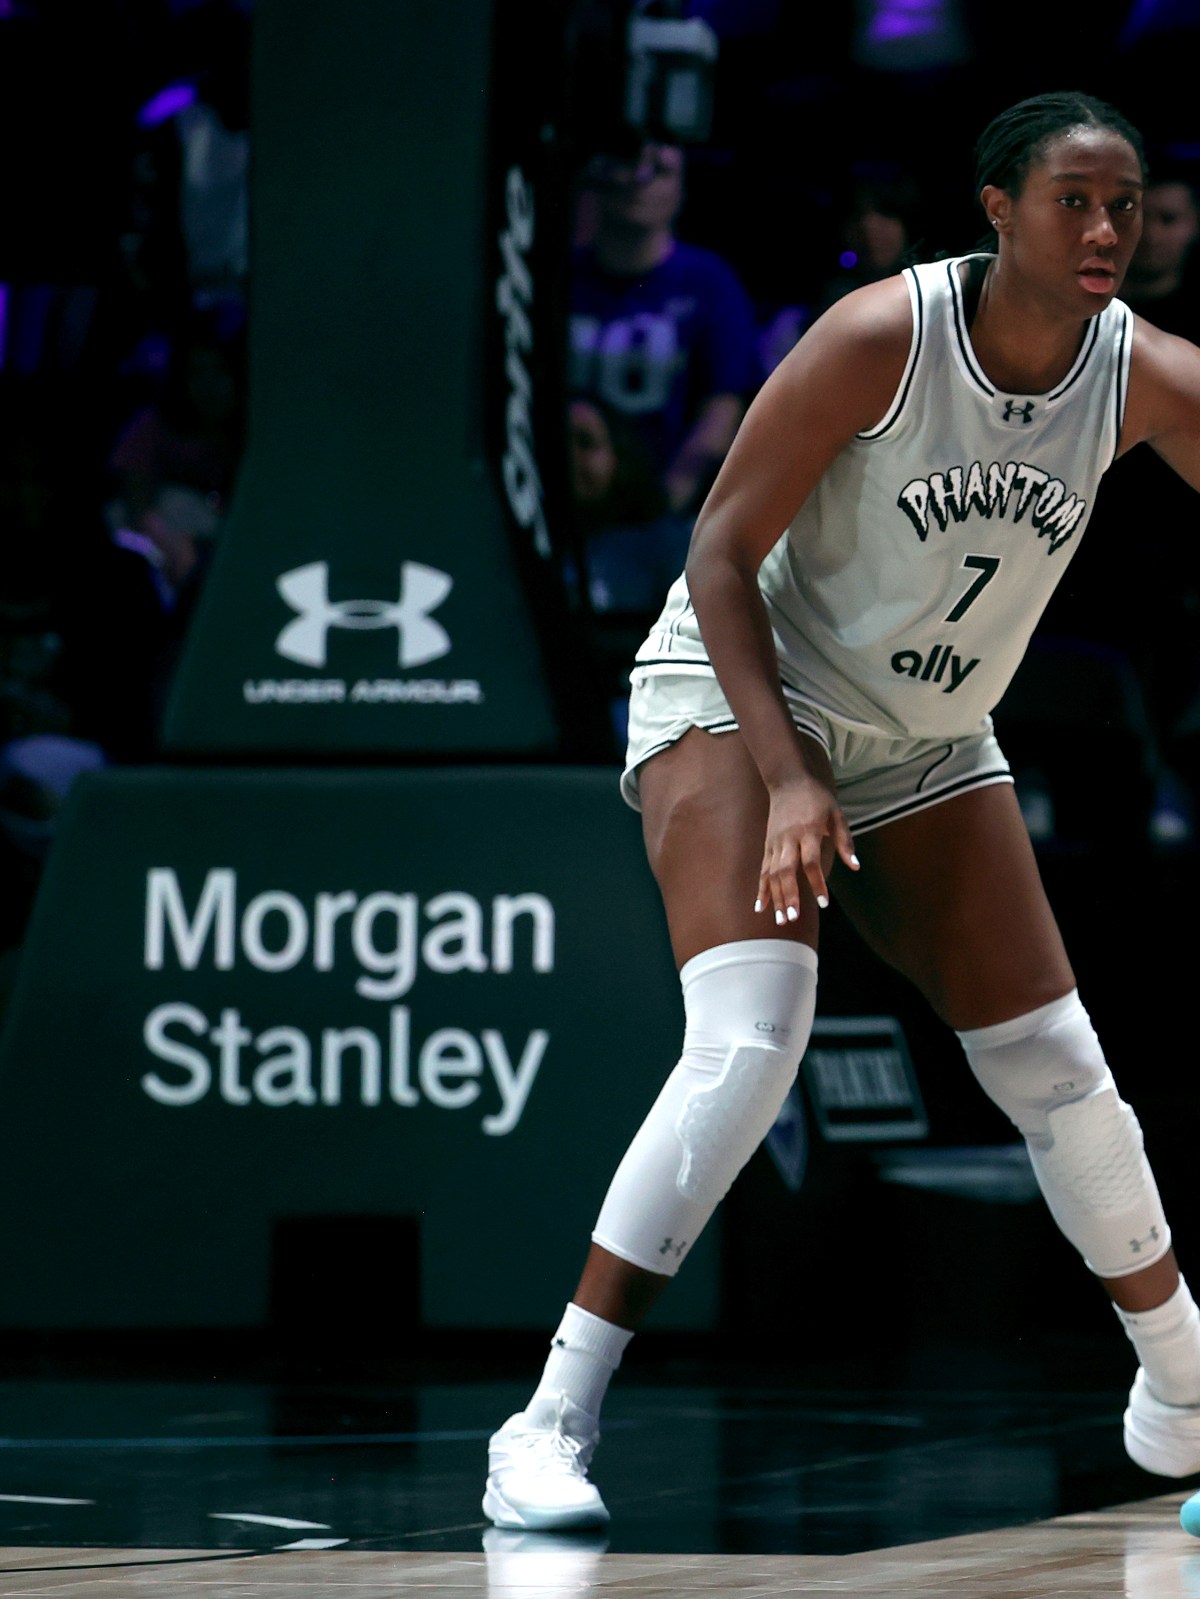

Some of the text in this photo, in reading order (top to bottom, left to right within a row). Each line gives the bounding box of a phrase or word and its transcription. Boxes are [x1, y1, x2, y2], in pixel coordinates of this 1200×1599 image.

[897, 461, 1086, 556] PHANTOM
[943, 552, 1003, 624] 7
[891, 644, 981, 693] ally
[143, 866, 556, 1000] Morgan
[141, 1002, 550, 1137] Stanley
